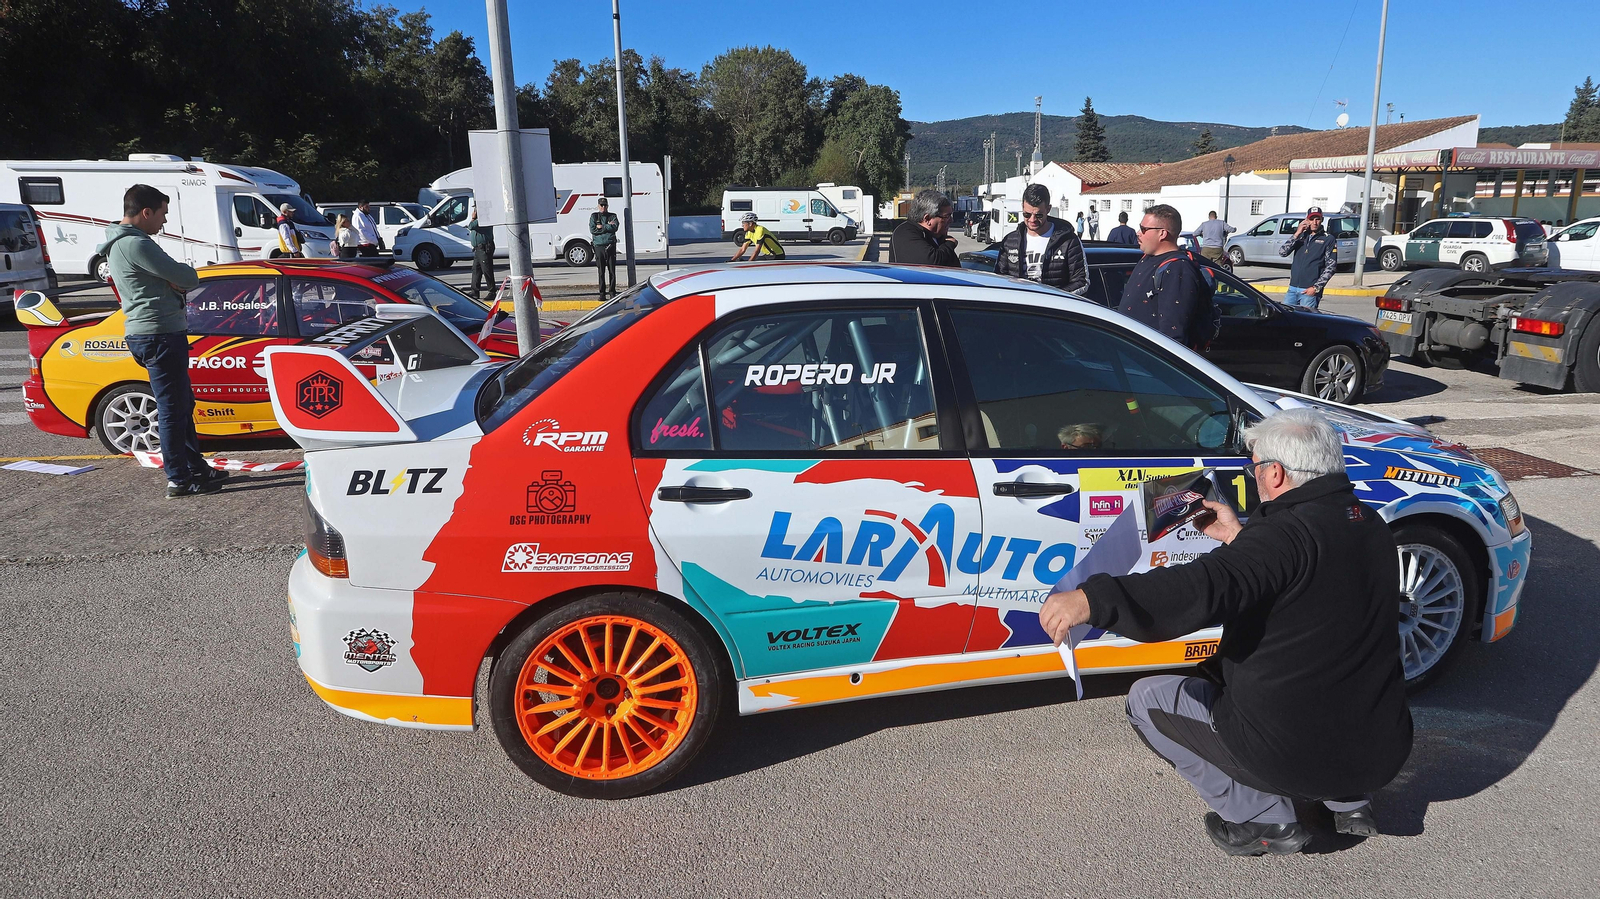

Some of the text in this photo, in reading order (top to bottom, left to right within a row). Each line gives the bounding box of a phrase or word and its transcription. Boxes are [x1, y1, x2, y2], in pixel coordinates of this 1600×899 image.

[1308, 154, 1407, 170] RESTAURANTE ISCINA
[1489, 151, 1566, 164] RESTAURANTE
[199, 300, 266, 310] J.B. Rosales
[1383, 310, 1396, 320] 7425
[84, 340, 126, 349] ROSALE
[188, 356, 246, 369] FAGOR
[744, 362, 896, 386] ROPERO JR
[650, 417, 705, 444] fresh.
[533, 431, 609, 451] RPM
[1117, 469, 1146, 481] XLV
[1384, 466, 1462, 487] MISHIMOTO
[509, 514, 591, 526] DSG PHOTOGRAPHY
[536, 552, 632, 565] SAMSONAS
[756, 567, 875, 588] AUTOMOVILES
[963, 584, 1049, 604] MULTIMARC
[766, 623, 862, 644] VOLTEX
[767, 643, 791, 651] VOLTEX
[1185, 643, 1218, 658] BRAID
[345, 652, 396, 662] MENTAL
